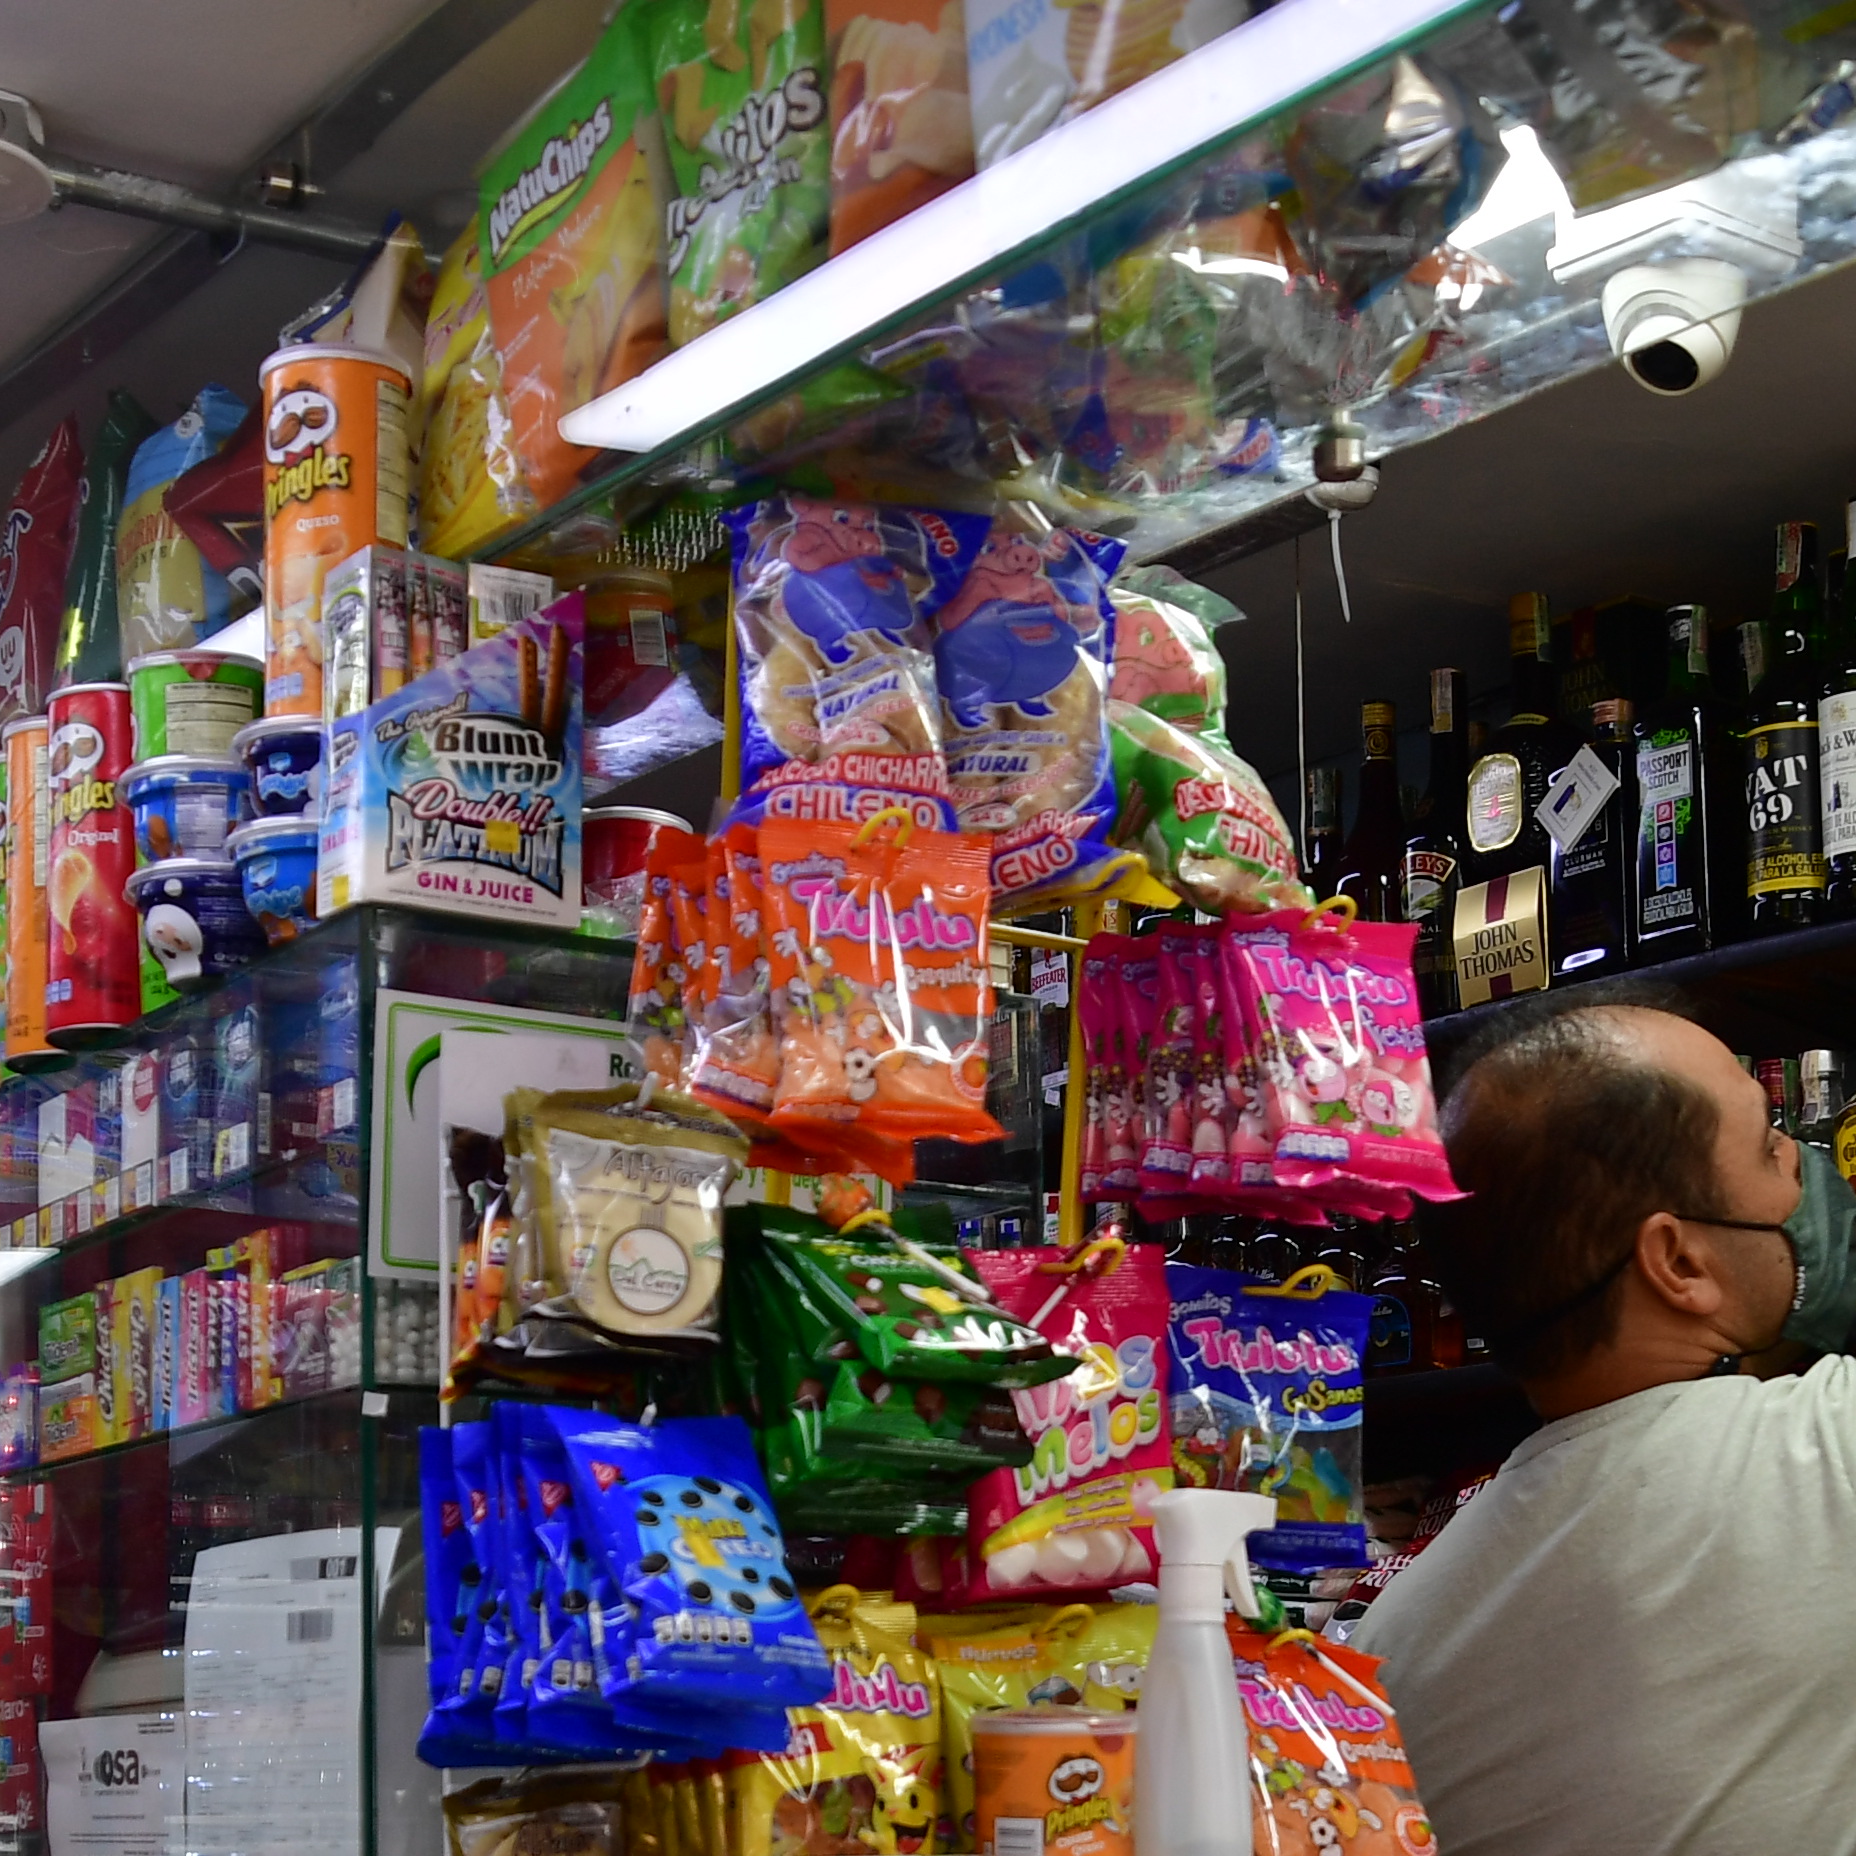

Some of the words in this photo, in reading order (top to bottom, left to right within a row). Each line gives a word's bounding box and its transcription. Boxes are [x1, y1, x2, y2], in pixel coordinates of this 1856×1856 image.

[489, 97, 614, 247] NatuChips
[375, 719, 404, 743] The
[435, 720, 546, 758] Blunt
[1639, 749, 1689, 777] PASSPORT
[1647, 768, 1681, 792] SCOTCH
[1748, 791, 1795, 834] 69
[1767, 854, 1810, 869] ALCOHOL
[417, 871, 459, 892] GIN
[462, 878, 474, 896] &
[477, 881, 534, 904] JUICE
[1470, 922, 1519, 957] JOHN
[1458, 940, 1536, 981] THOMAS
[1185, 1316, 1358, 1375] Trululu
